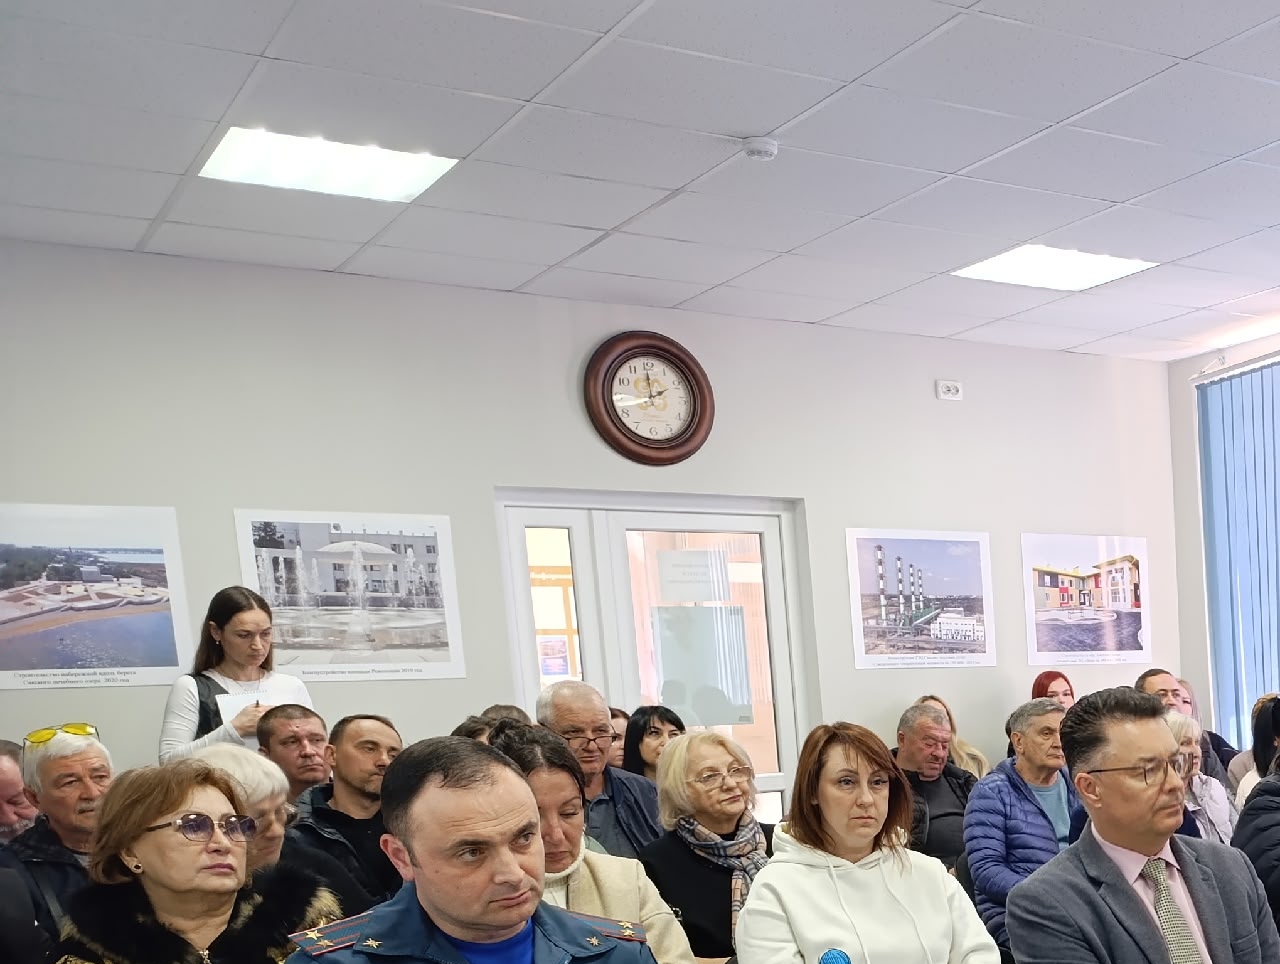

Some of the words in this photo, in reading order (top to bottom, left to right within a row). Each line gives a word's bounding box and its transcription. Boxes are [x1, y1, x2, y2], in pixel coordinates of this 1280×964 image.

[629, 365, 637, 374] 11
[643, 362, 654, 371] 12
[618, 377, 630, 386] 10
[672, 380, 681, 389] 2
[621, 408, 630, 418] 8
[633, 421, 641, 430] 7
[649, 427, 658, 436] 6
